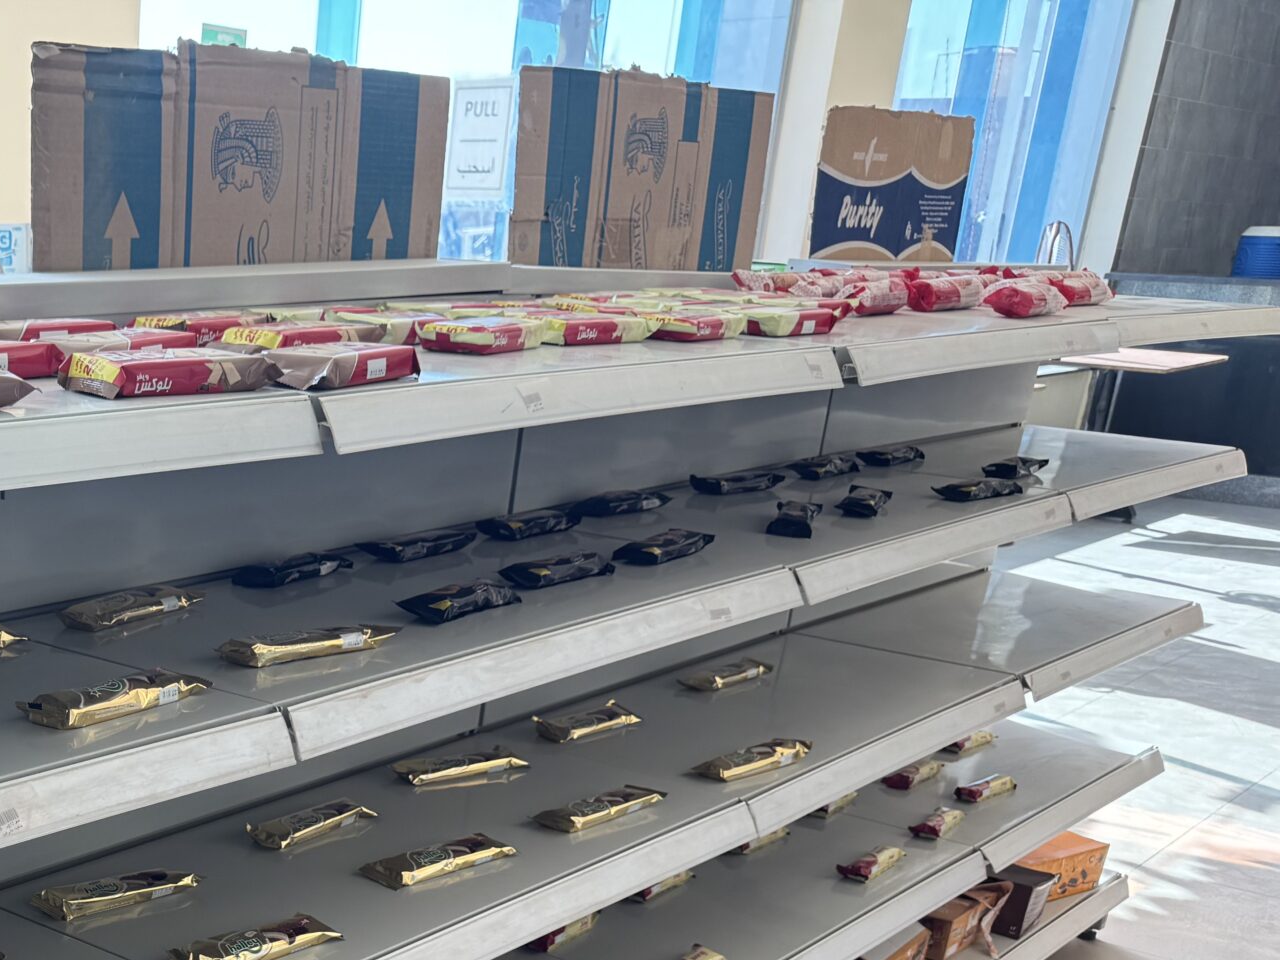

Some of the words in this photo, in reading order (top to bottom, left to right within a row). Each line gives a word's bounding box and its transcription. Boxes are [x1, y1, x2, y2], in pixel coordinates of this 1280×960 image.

[464, 100, 499, 118] PULL
[837, 191, 884, 239] Purity
[134, 378, 173, 395] بلوكس
[83, 880, 120, 897] halley
[226, 935, 263, 954] halley
